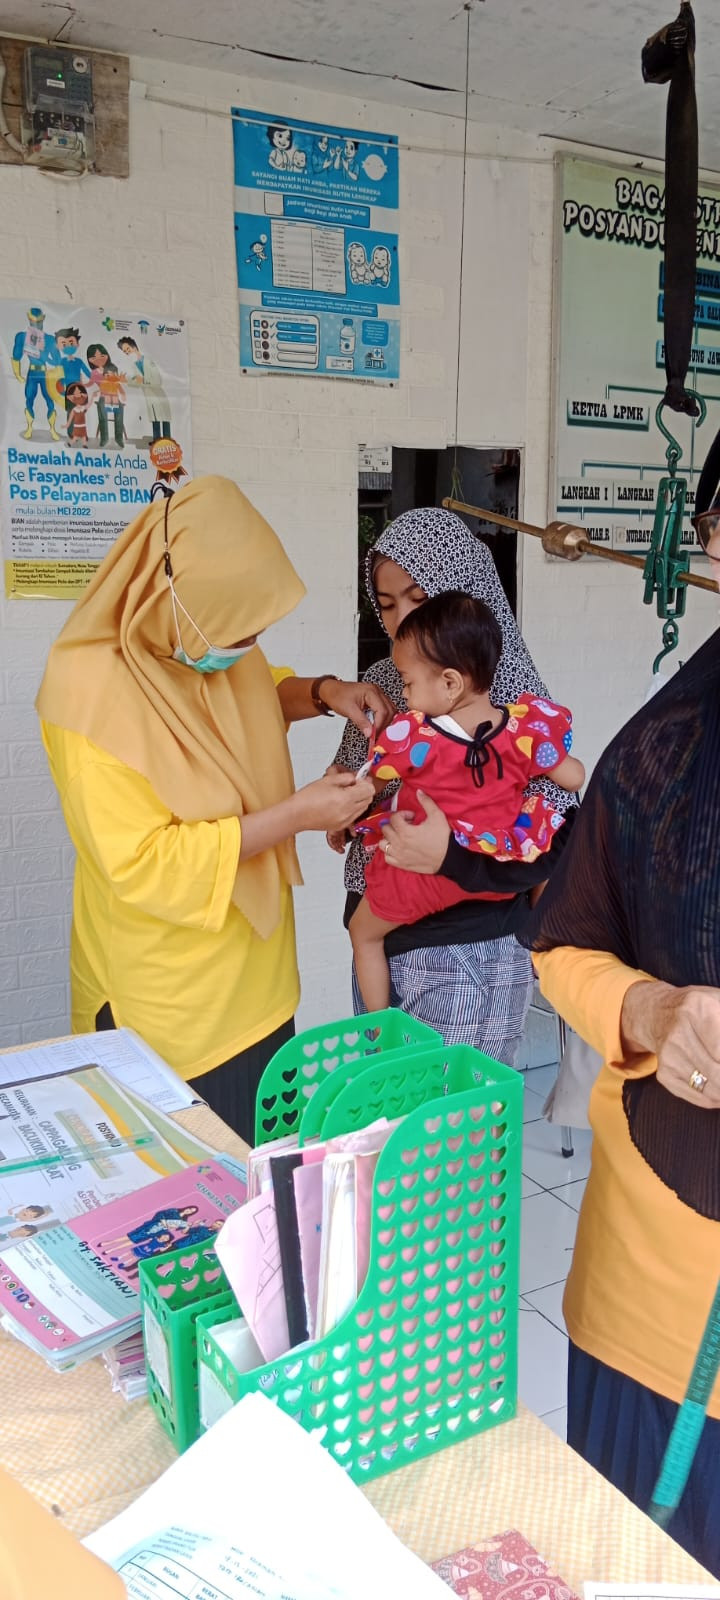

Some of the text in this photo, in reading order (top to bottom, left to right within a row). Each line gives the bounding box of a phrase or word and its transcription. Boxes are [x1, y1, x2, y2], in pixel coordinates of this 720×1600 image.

[615, 177, 665, 215] BAG
[572, 401, 644, 421] KETUA LPMK
[7, 447, 71, 466] Bawalah
[74, 451, 111, 468] Anak
[114, 454, 147, 470] Anda
[9, 466, 25, 482] ke
[114, 470, 138, 486] dan
[9, 484, 152, 505] Pos Pelayanan BIAN
[561, 485, 608, 501] LANGKAH I
[617, 486, 654, 502] LANGKAH
[15, 506, 91, 517] mulai bulan MEI 2022
[18, 1123, 49, 1157] BACUKIKI
[89, 1255, 138, 1299] SAKTIANI
